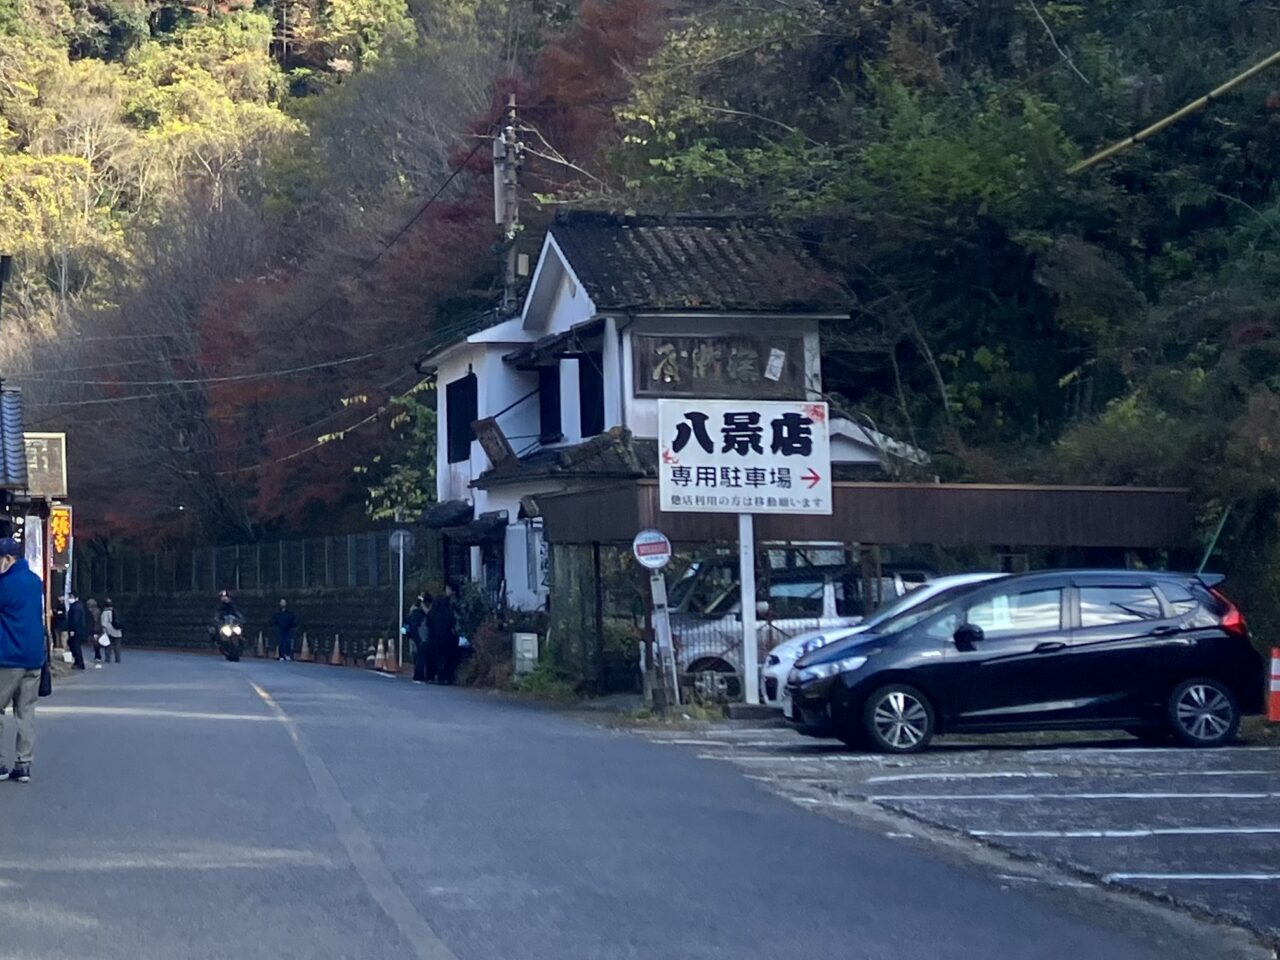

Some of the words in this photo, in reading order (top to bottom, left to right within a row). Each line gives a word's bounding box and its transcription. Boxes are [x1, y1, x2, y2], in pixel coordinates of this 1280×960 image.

[672, 411, 813, 456] 八景店
[671, 466, 792, 489] 専用駐車場
